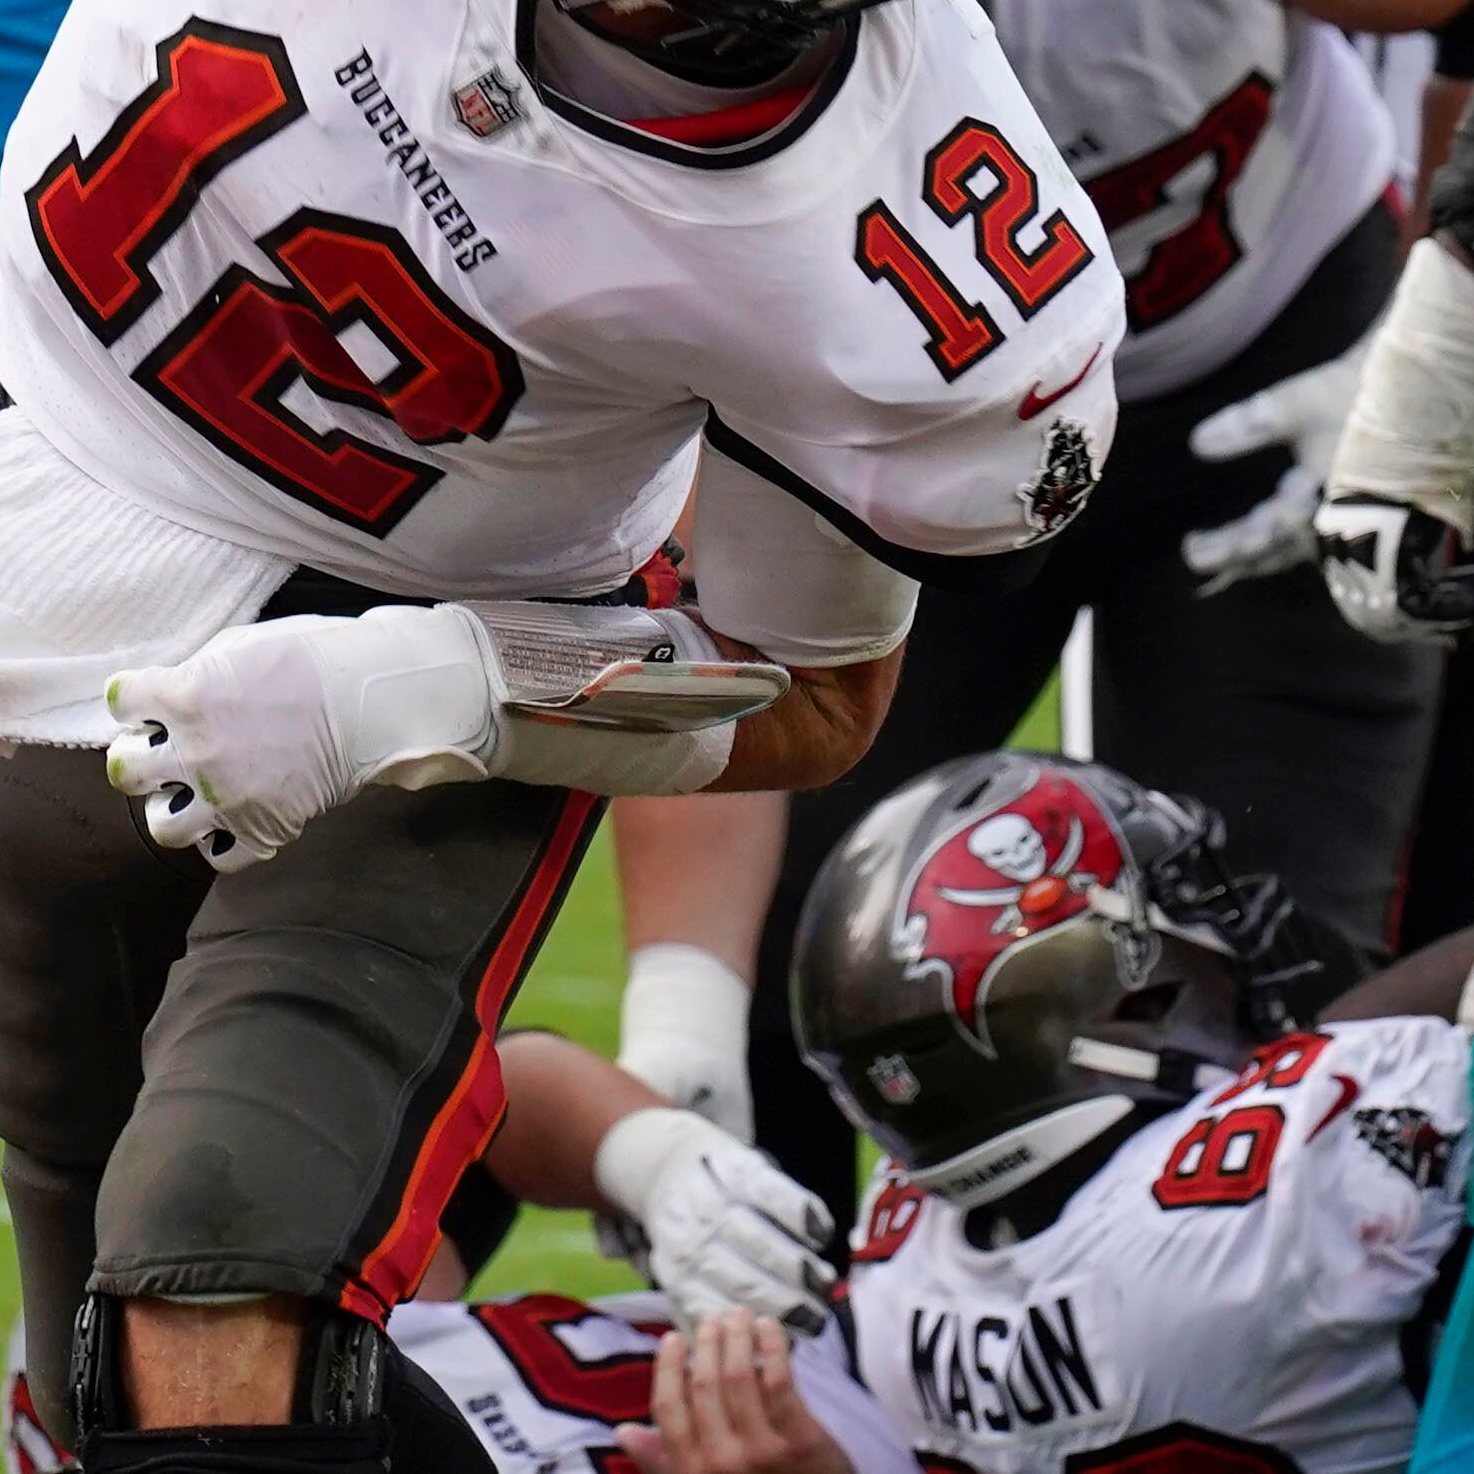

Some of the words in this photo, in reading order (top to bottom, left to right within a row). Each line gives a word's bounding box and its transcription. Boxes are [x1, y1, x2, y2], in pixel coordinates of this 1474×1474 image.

[24, 16, 526, 541] 12
[334, 42, 499, 274] BUCCANEERS
[854, 116, 1095, 384] 12
[912, 1296, 1102, 1431] MASON
